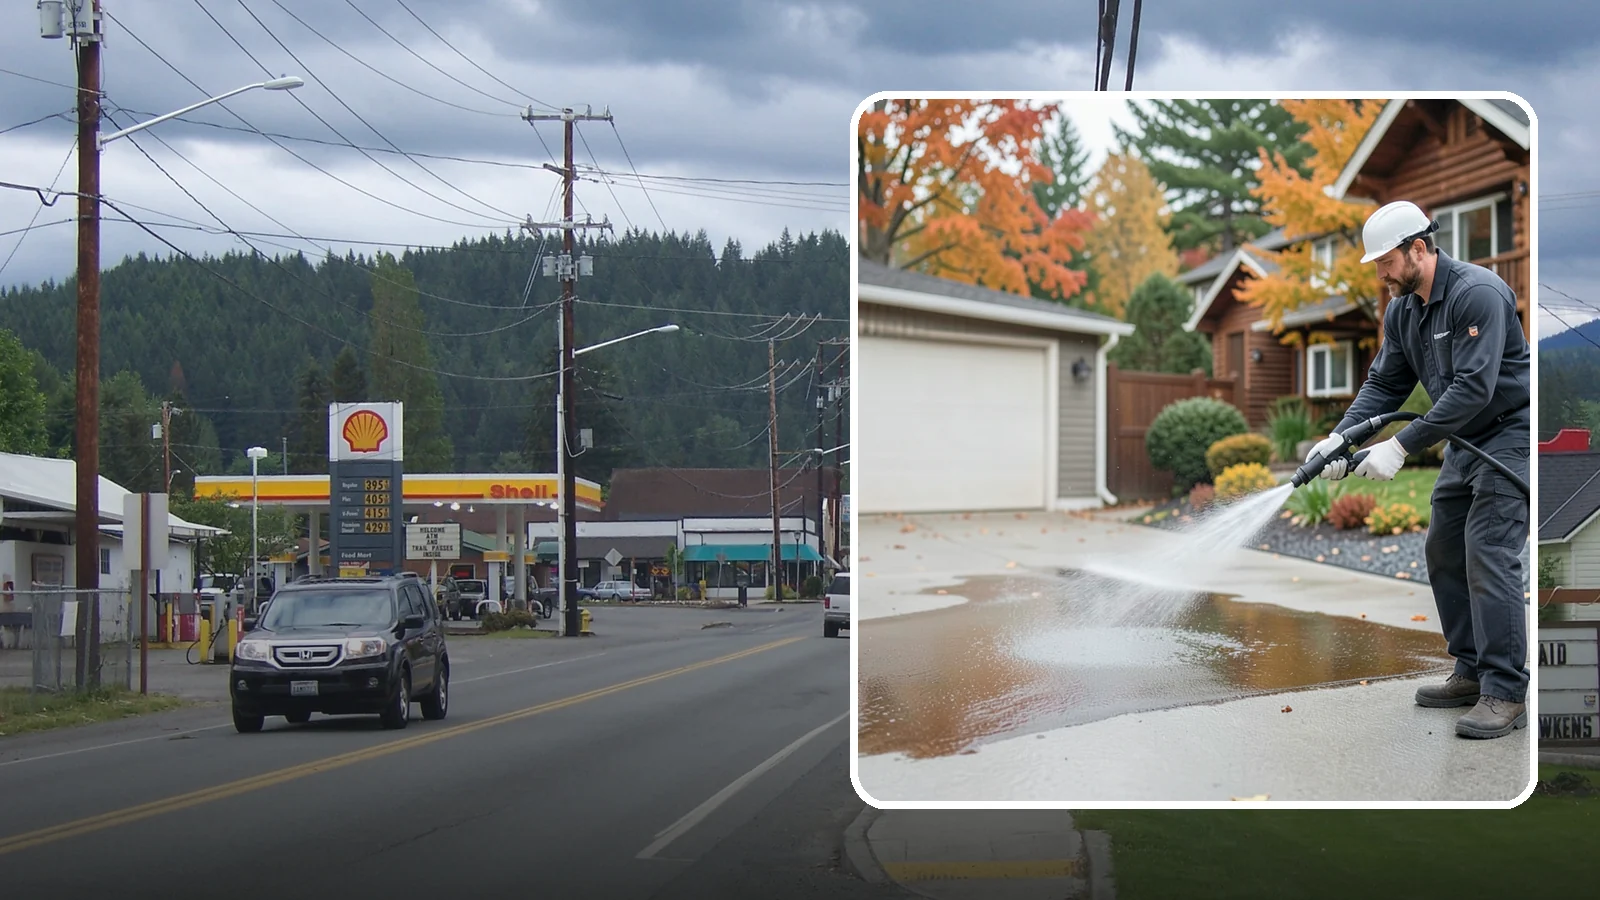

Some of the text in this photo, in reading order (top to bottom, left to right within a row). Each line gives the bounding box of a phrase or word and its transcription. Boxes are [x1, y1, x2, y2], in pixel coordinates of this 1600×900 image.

[366, 480, 383, 490] 395
[489, 484, 547, 499] Shell
[366, 494, 383, 504] 405
[366, 508, 383, 518] 415
[366, 522, 383, 532] 429
